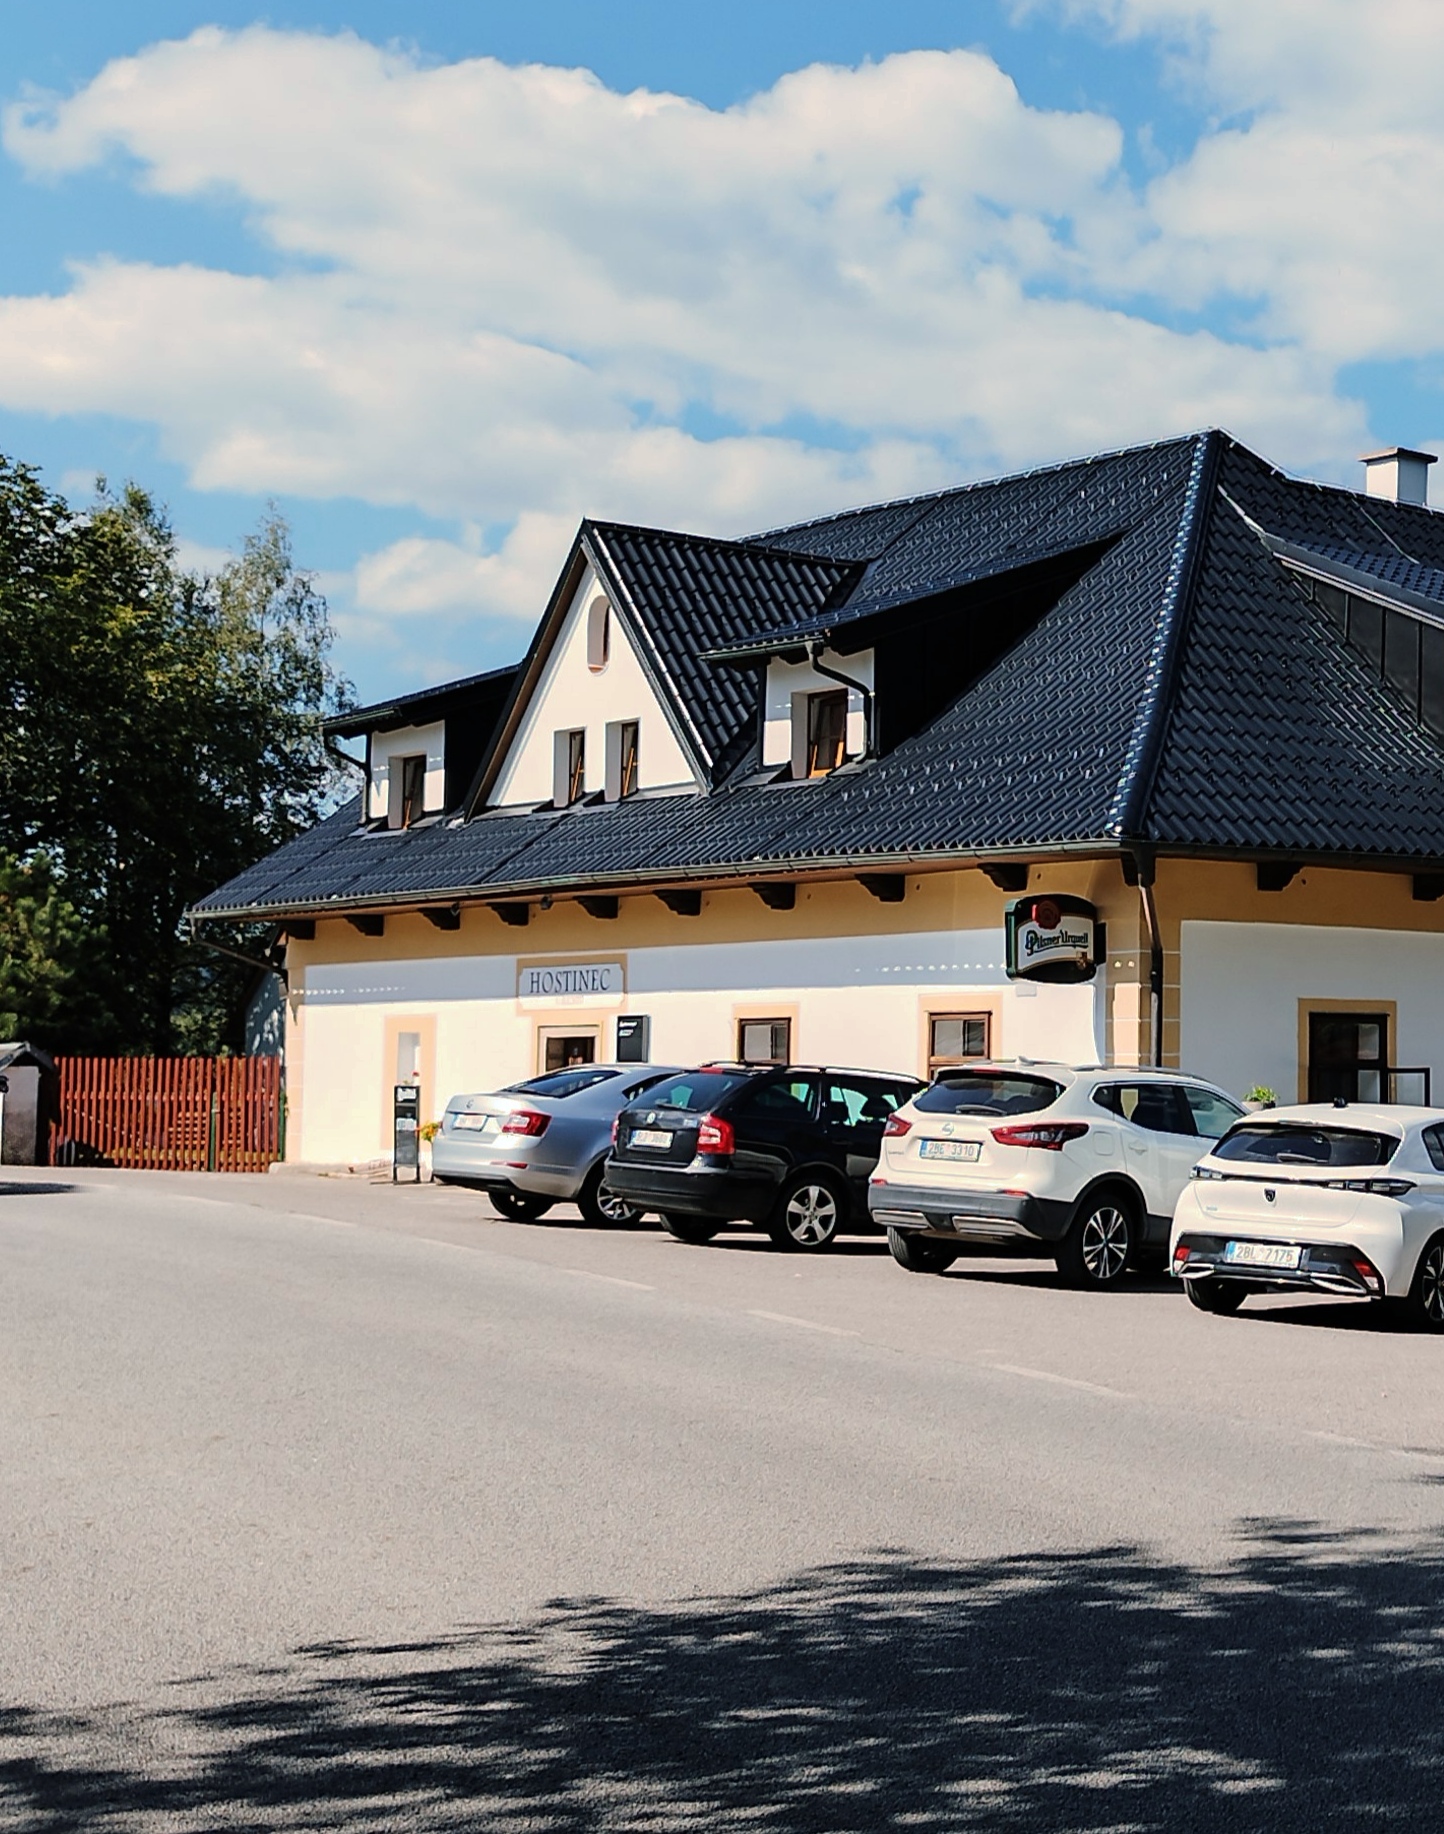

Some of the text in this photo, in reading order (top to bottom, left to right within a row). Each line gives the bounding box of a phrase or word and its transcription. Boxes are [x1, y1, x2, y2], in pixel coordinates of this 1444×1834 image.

[1025, 929, 1088, 956] Pilsner Urquell
[530, 968, 611, 993] HOSTINEC
[1236, 1246, 1294, 1262] 2BL 7175
